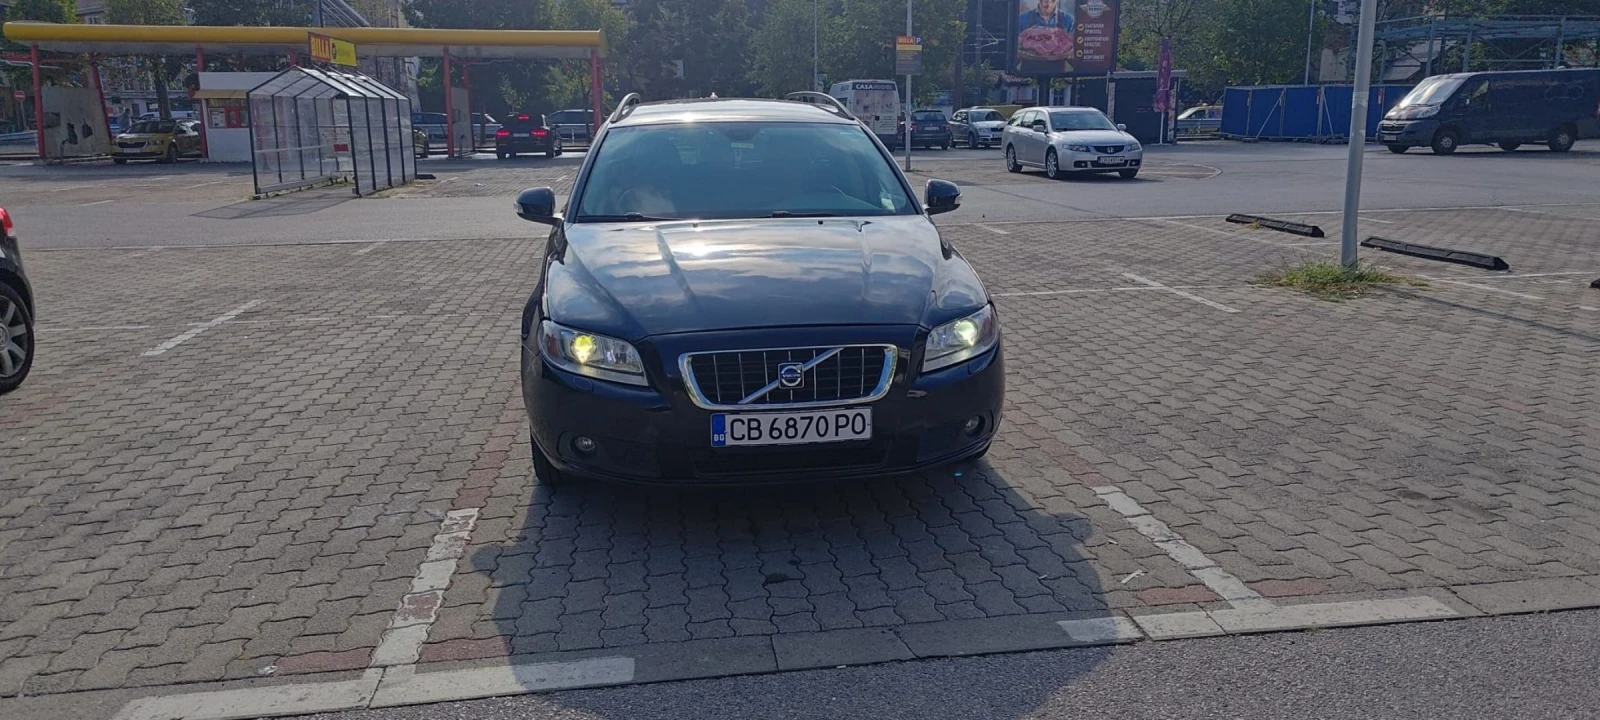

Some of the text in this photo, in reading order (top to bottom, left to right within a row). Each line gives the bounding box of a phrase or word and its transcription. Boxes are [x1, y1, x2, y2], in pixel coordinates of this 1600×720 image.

[310, 36, 330, 60] BILLA
[730, 412, 866, 440] CB 6870 PO
